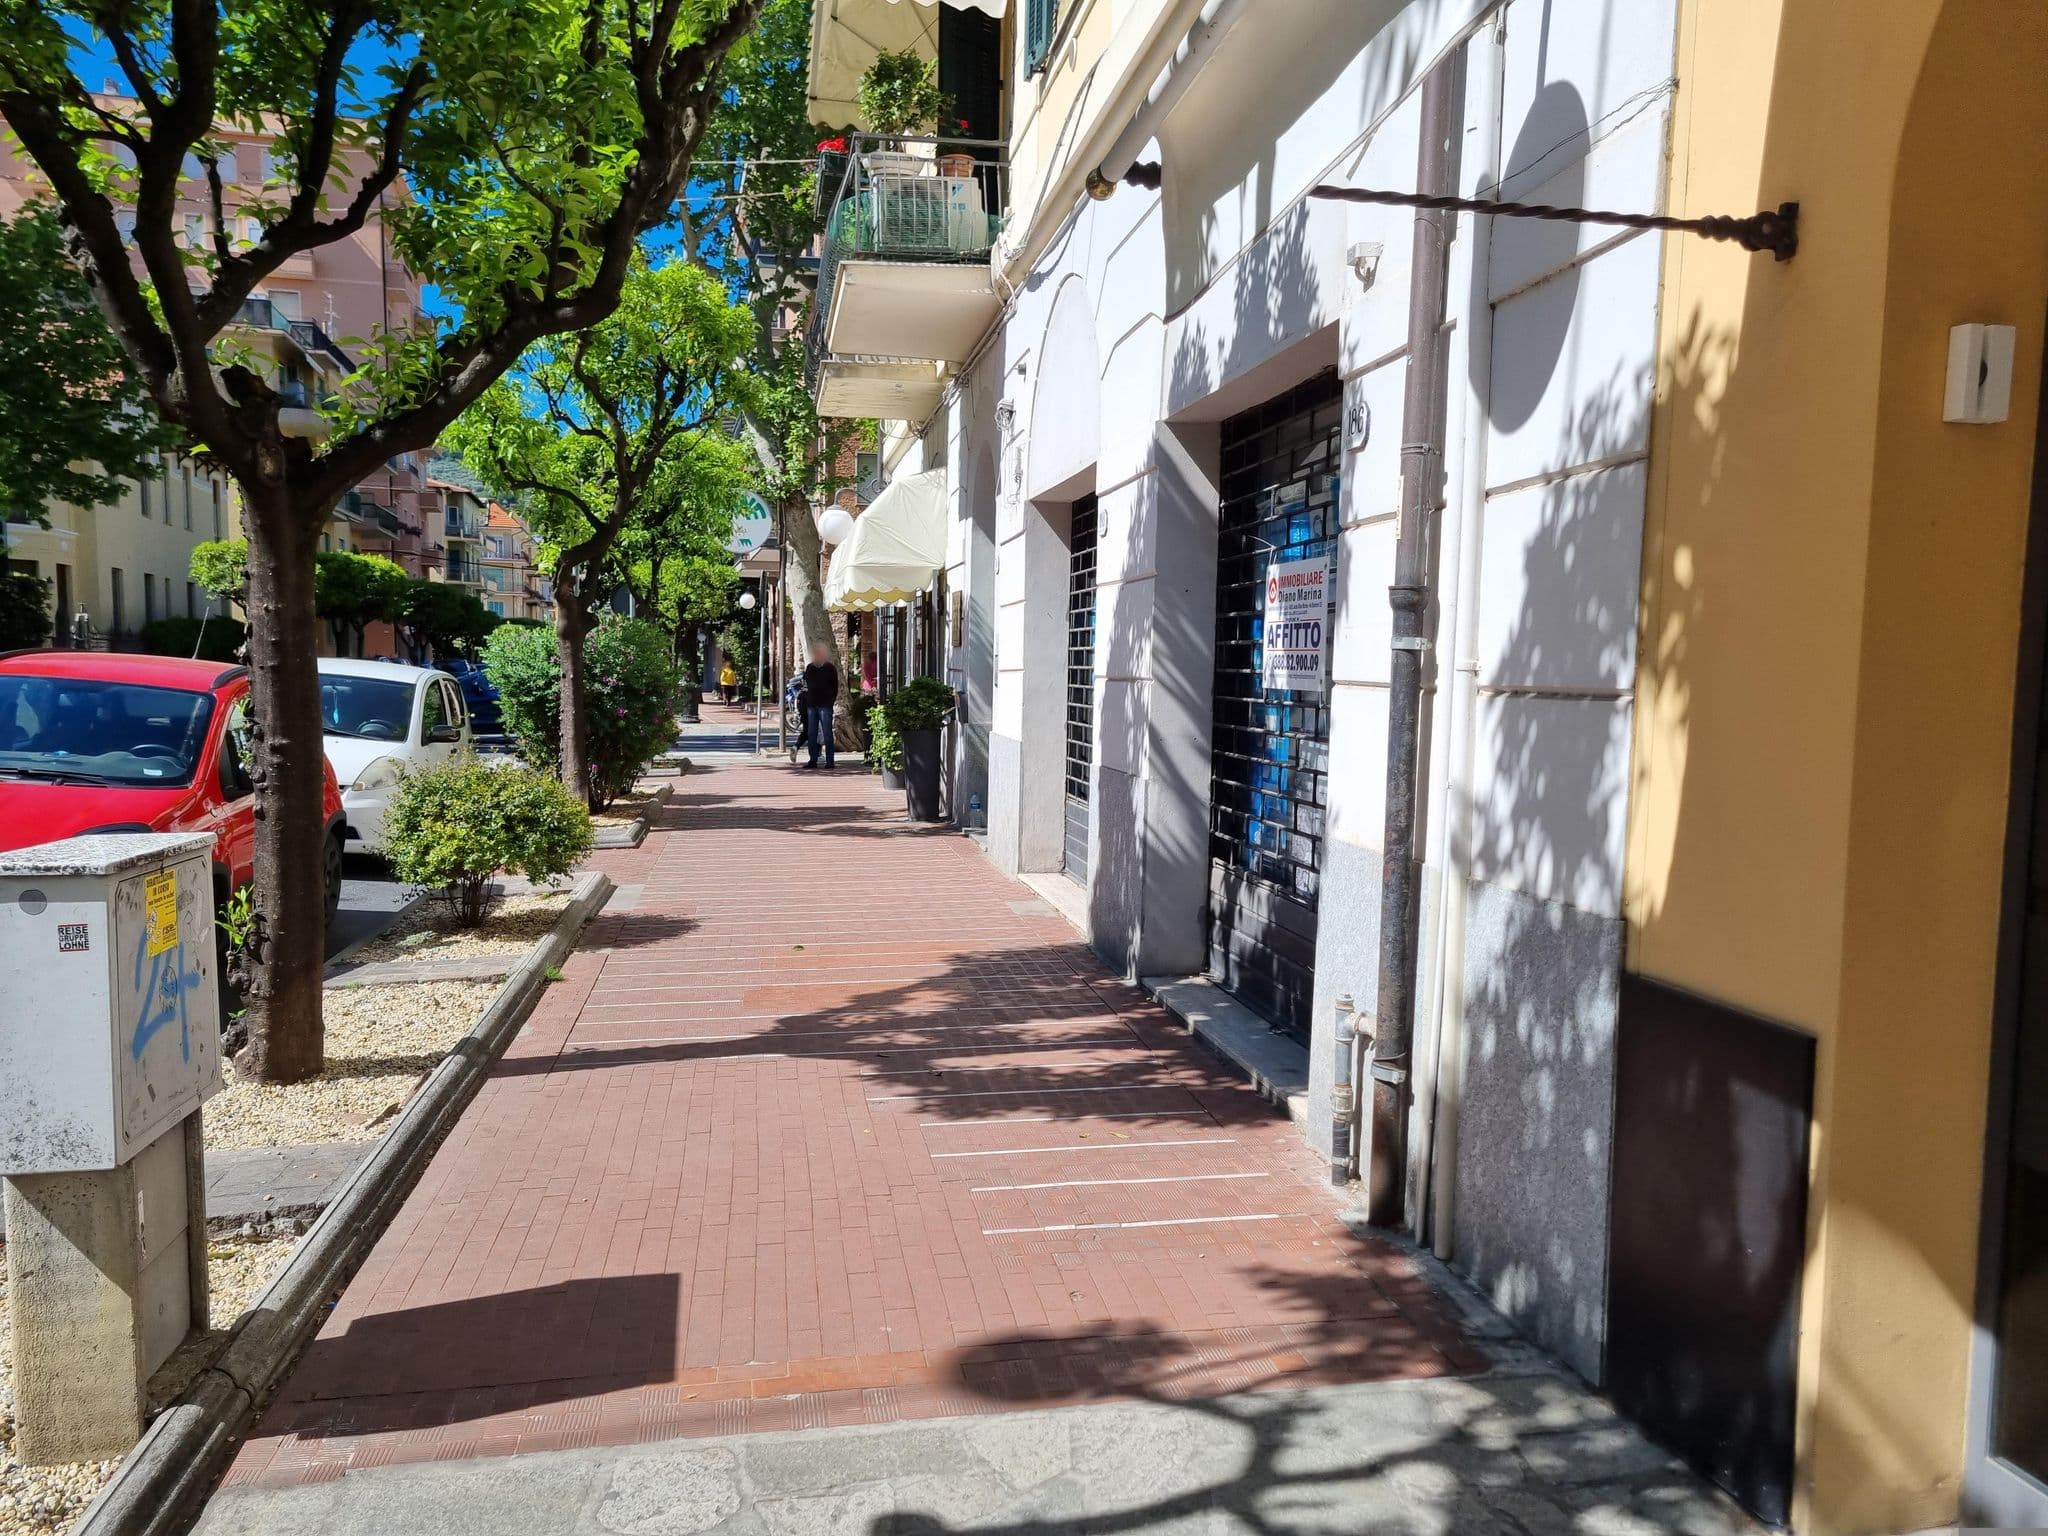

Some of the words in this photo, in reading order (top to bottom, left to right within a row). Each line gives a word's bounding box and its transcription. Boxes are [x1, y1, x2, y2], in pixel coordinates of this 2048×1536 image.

[1347, 405, 1364, 437] 186
[1278, 570, 1324, 589] IMMOBILIARE
[1278, 590, 1296, 602] Diano
[1297, 587, 1322, 601] Marina
[1267, 622, 1321, 649] AFFITTO
[58, 926, 89, 935] REISE
[59, 933, 89, 942] GRUPPE
[59, 940, 90, 950] LOHNE
